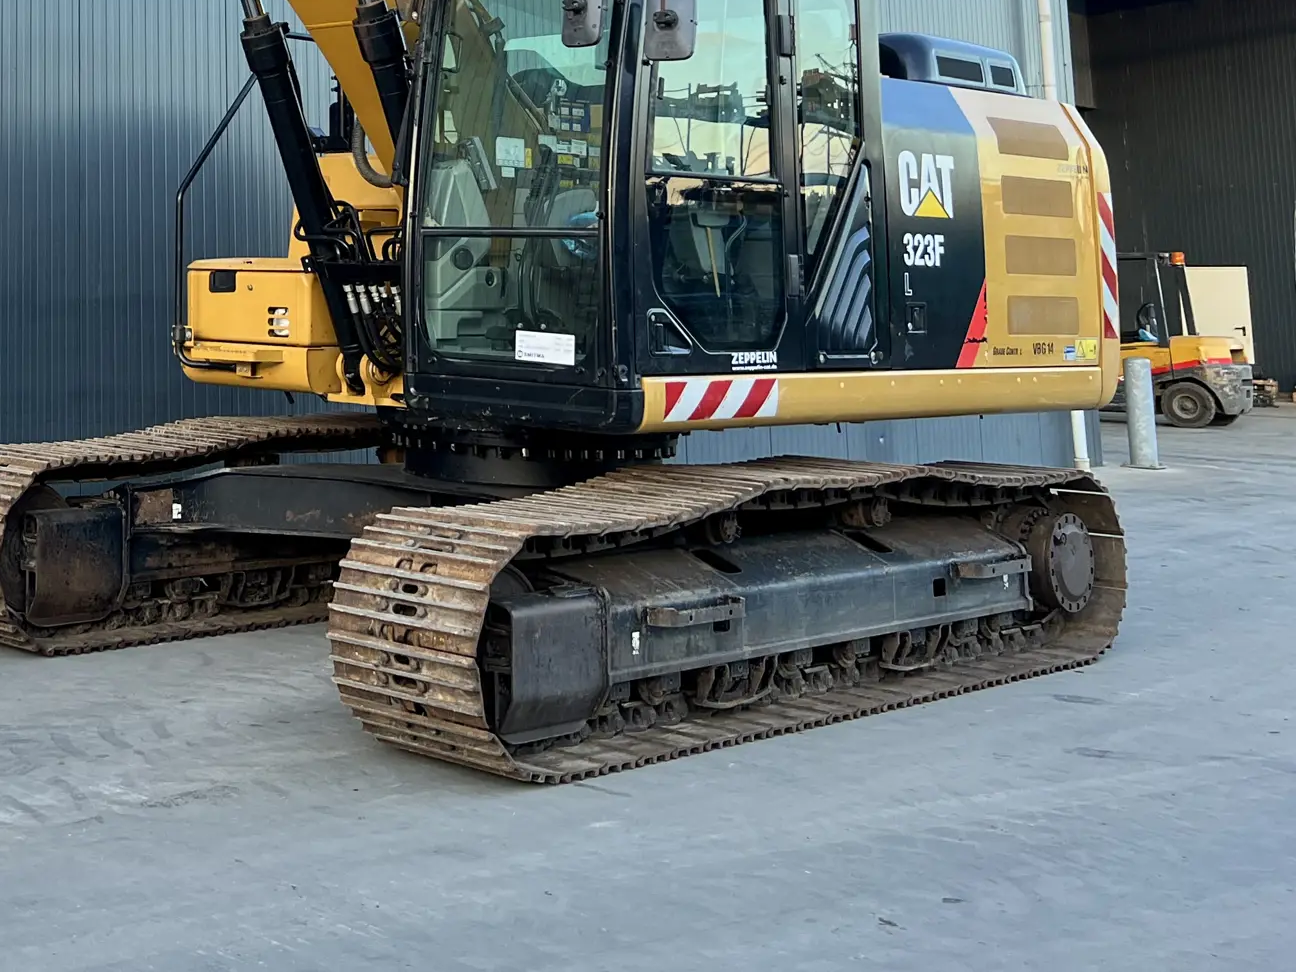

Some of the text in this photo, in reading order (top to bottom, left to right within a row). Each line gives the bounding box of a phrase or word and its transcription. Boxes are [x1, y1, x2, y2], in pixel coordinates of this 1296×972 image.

[898, 150, 954, 219] CAT
[903, 232, 945, 267] 323F
[904, 272, 913, 296] L
[731, 351, 777, 365] ZEPPELIN
